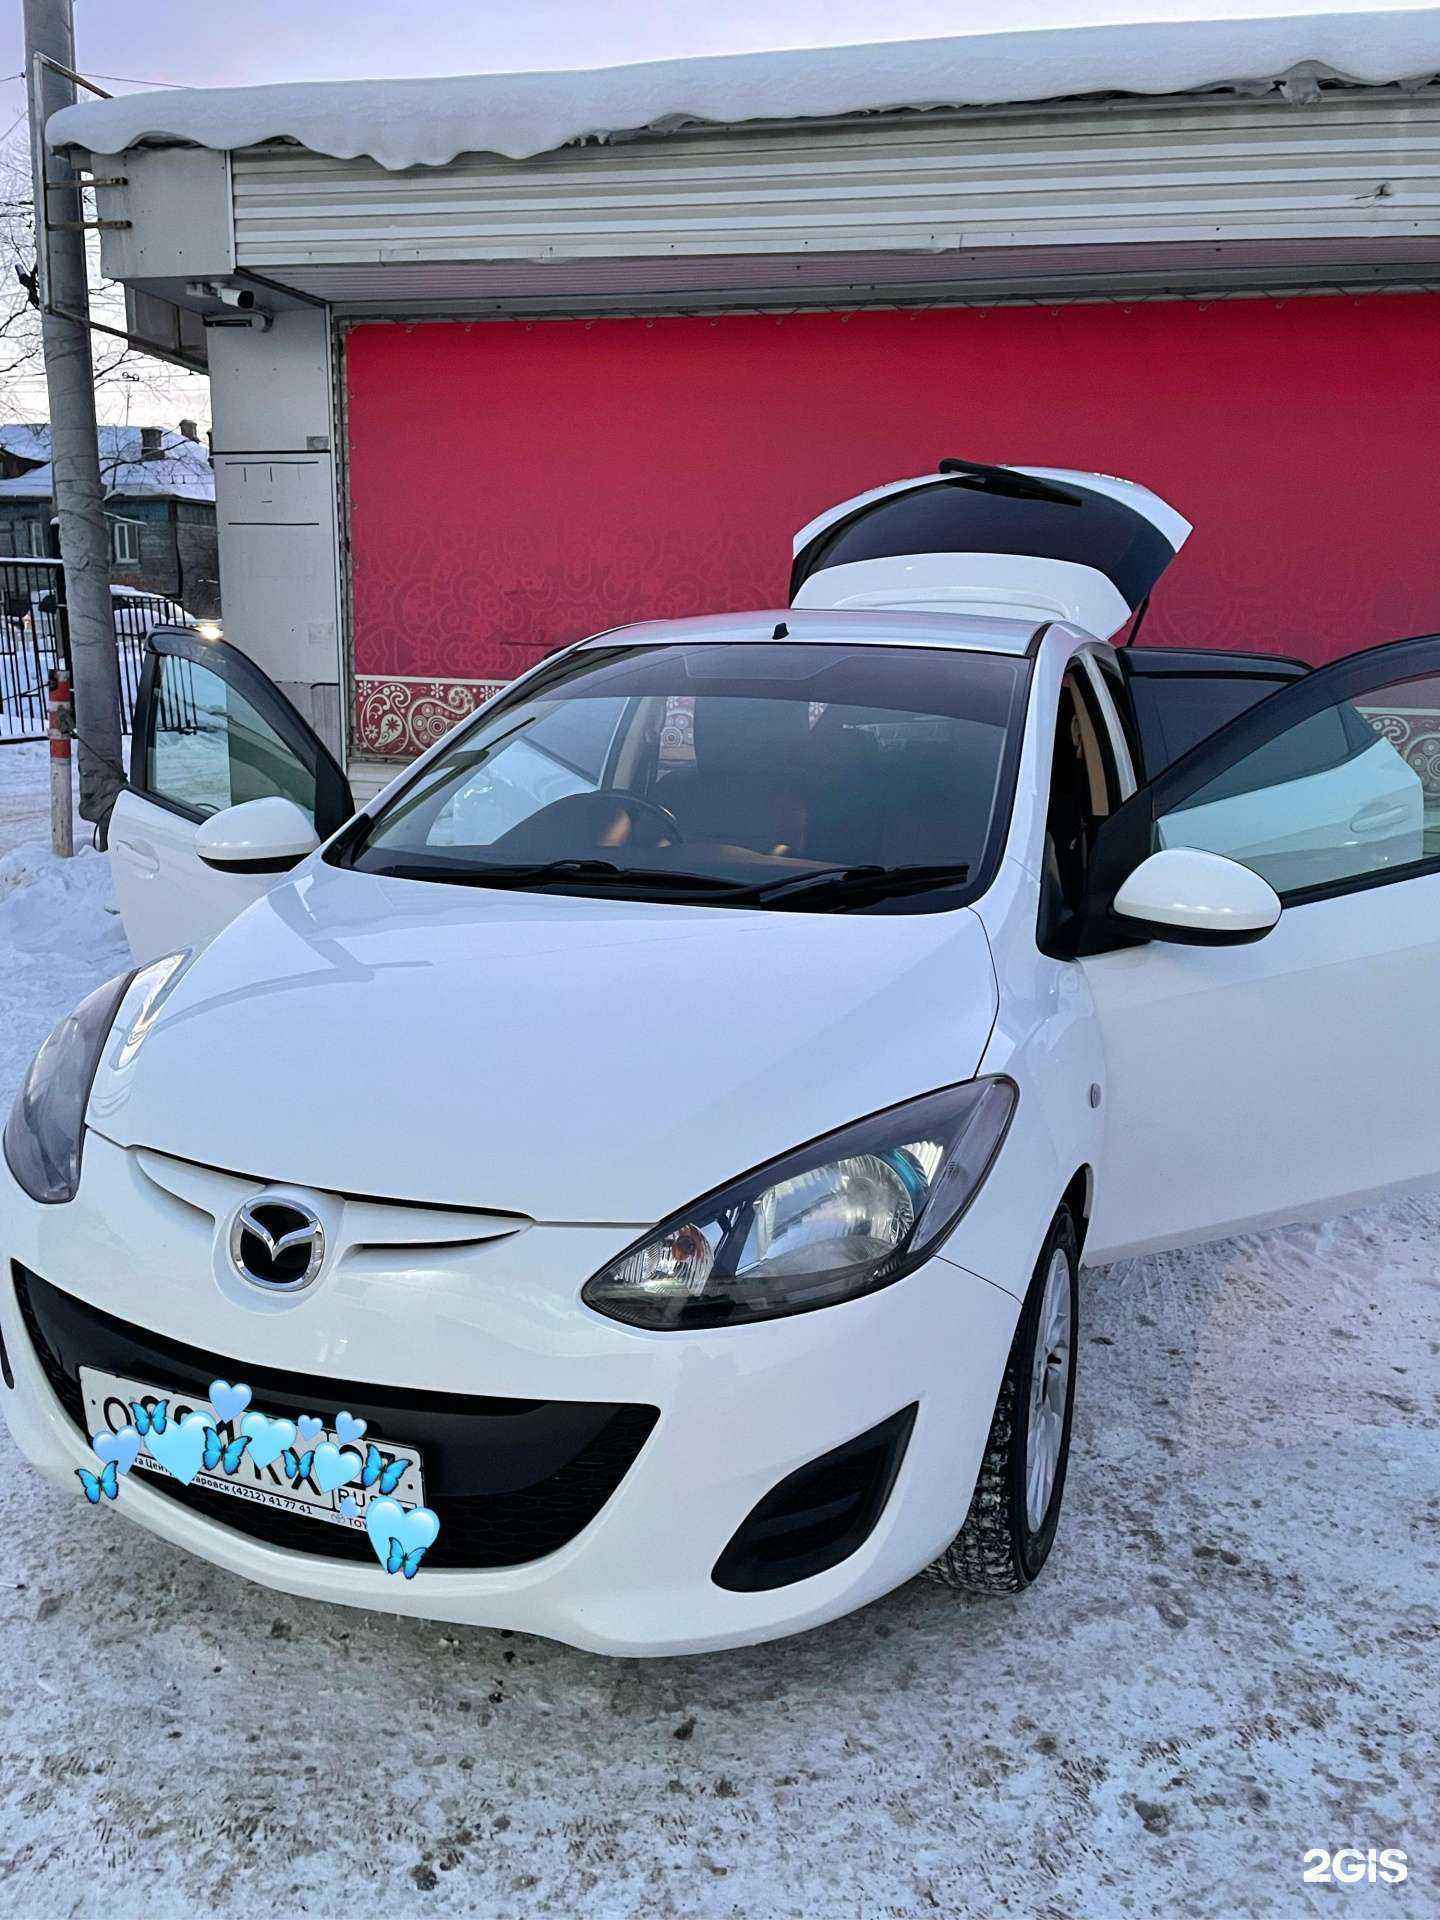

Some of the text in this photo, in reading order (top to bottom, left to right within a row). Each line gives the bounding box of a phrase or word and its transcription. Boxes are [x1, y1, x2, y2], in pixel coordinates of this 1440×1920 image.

[232, 1484, 266, 1503] (4212)
[268, 1496, 283, 1506] 41
[285, 1499, 297, 1509] 77
[299, 1504, 313, 1515] 41
